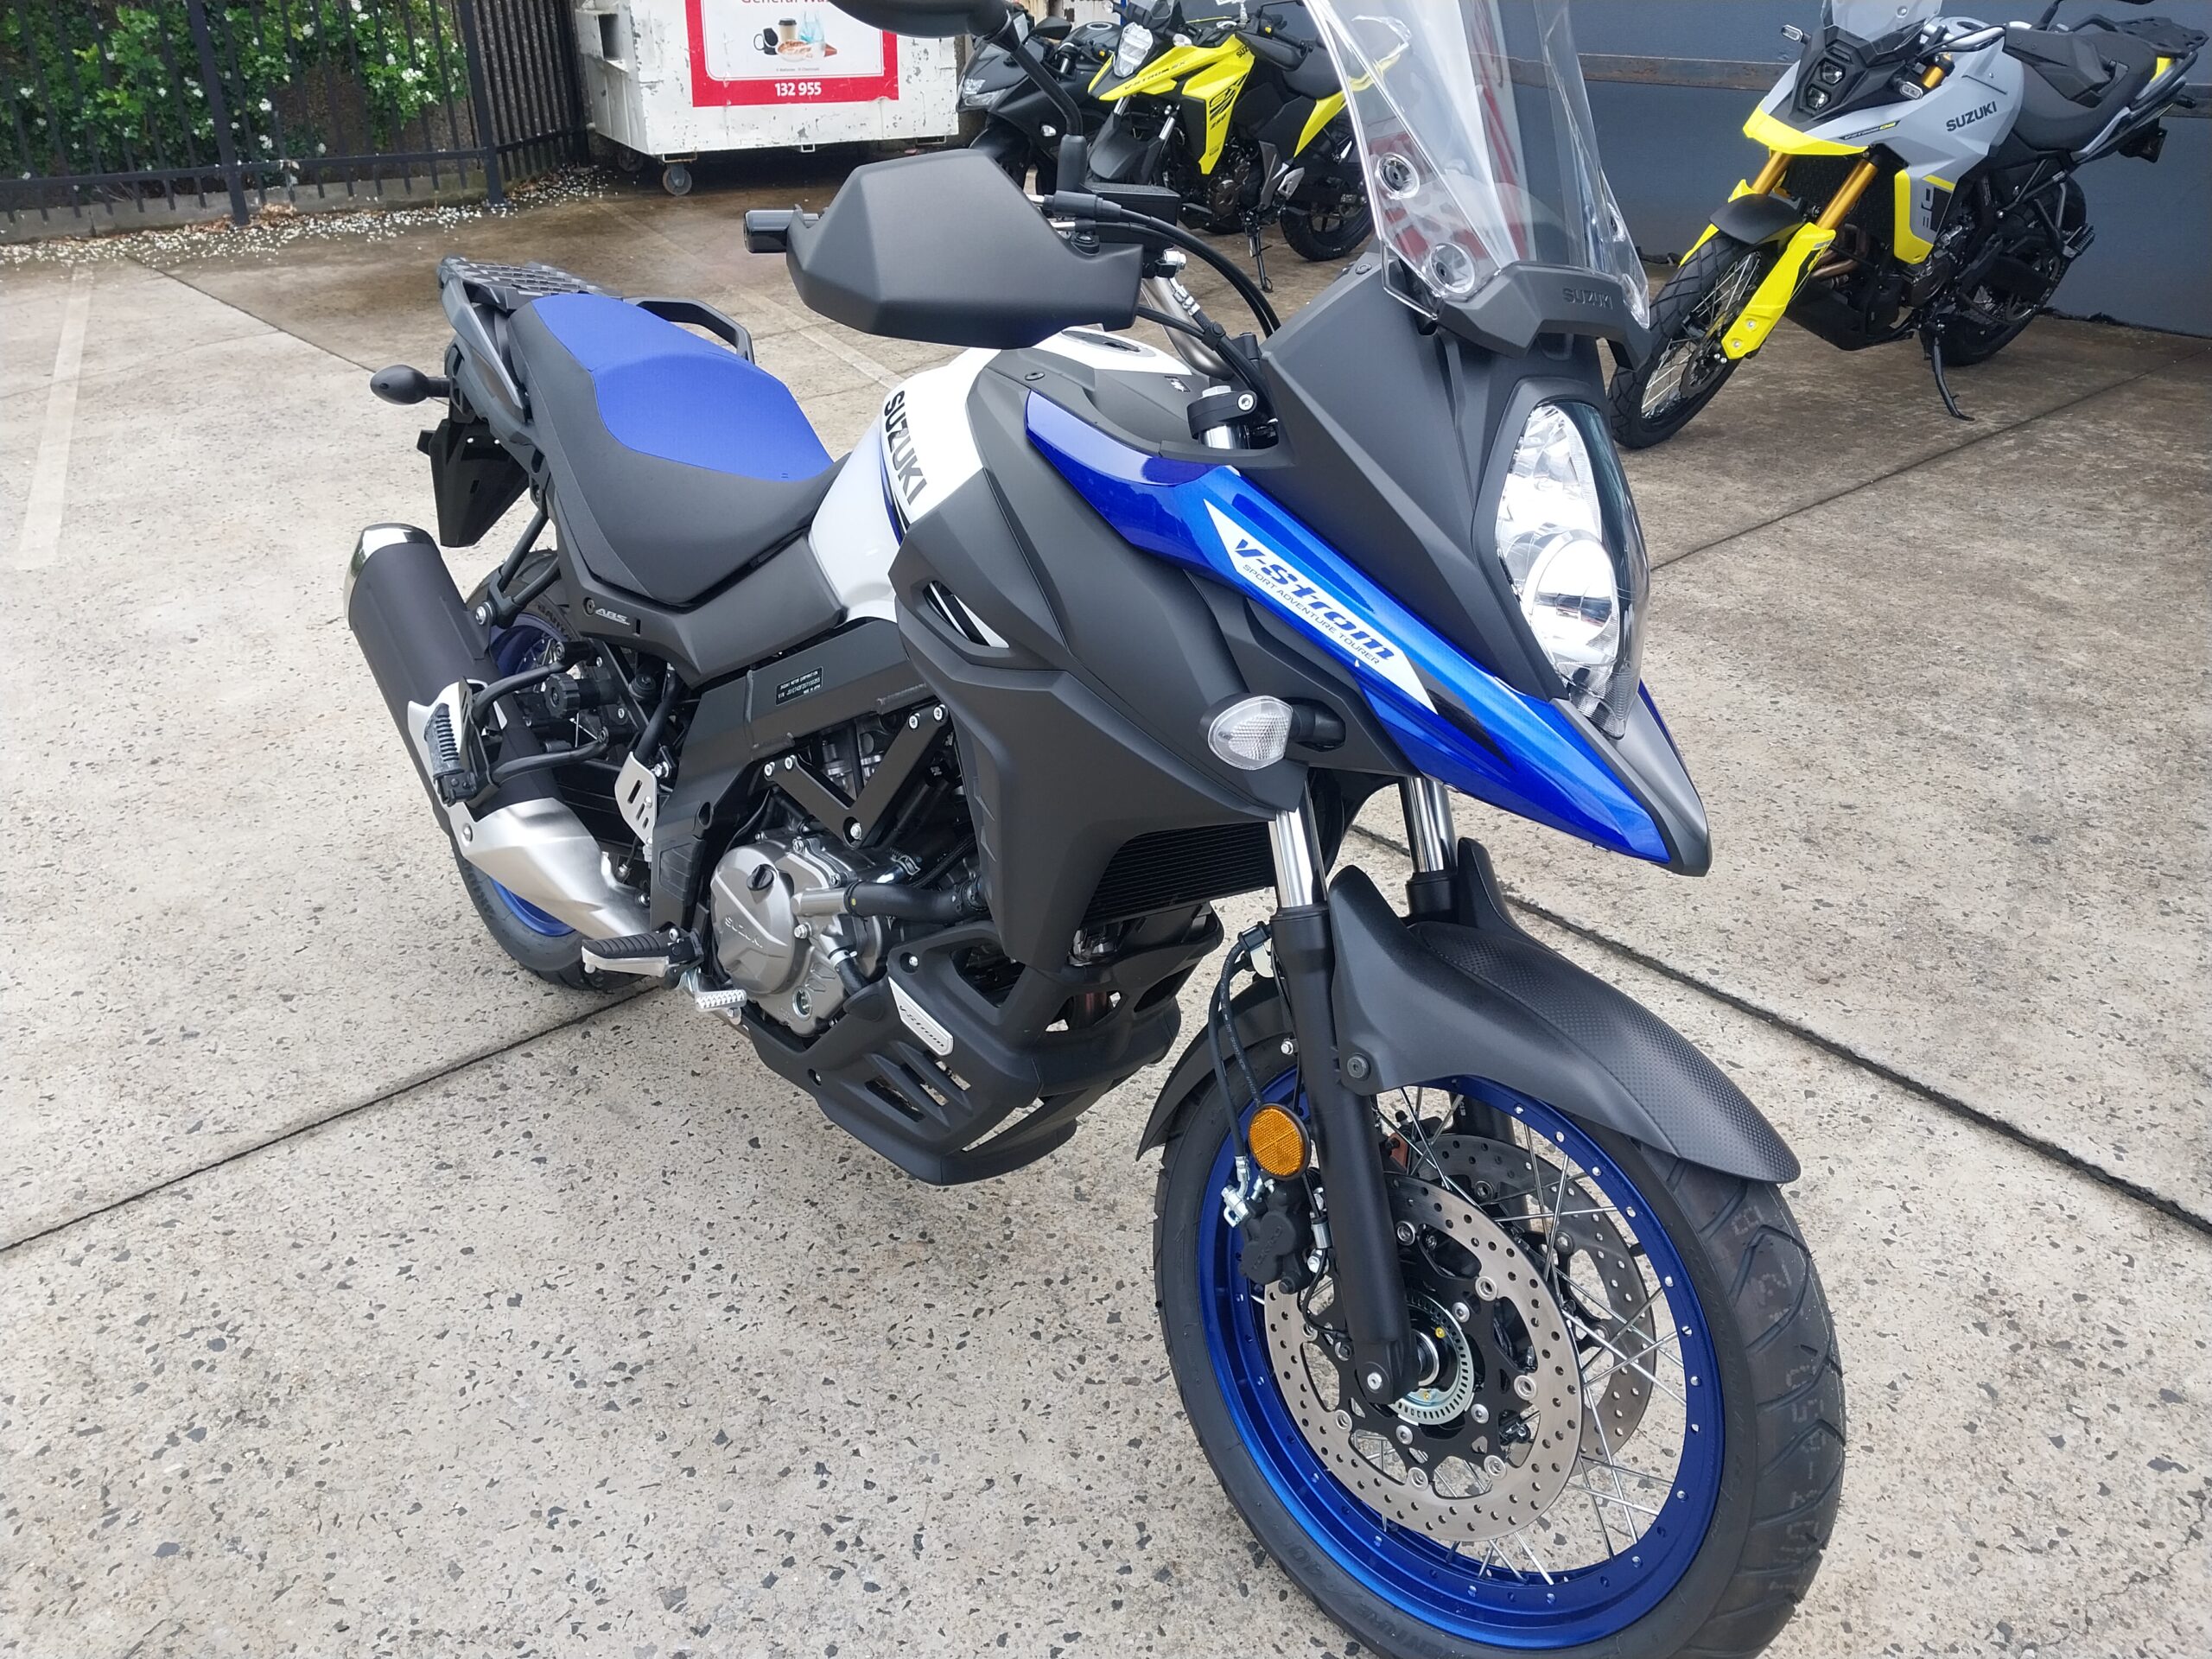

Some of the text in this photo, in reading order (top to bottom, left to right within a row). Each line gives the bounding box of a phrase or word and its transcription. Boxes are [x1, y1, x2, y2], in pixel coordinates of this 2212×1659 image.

[774, 81, 822, 97] 132 955
[1946, 100, 1998, 132] SUZUKI
[1562, 288, 1613, 311] SUZUKI
[884, 390, 928, 506] SUZUKI
[595, 607, 629, 626] ABS
[1243, 563, 1380, 664] SPORT ADVENTURE TOURER
